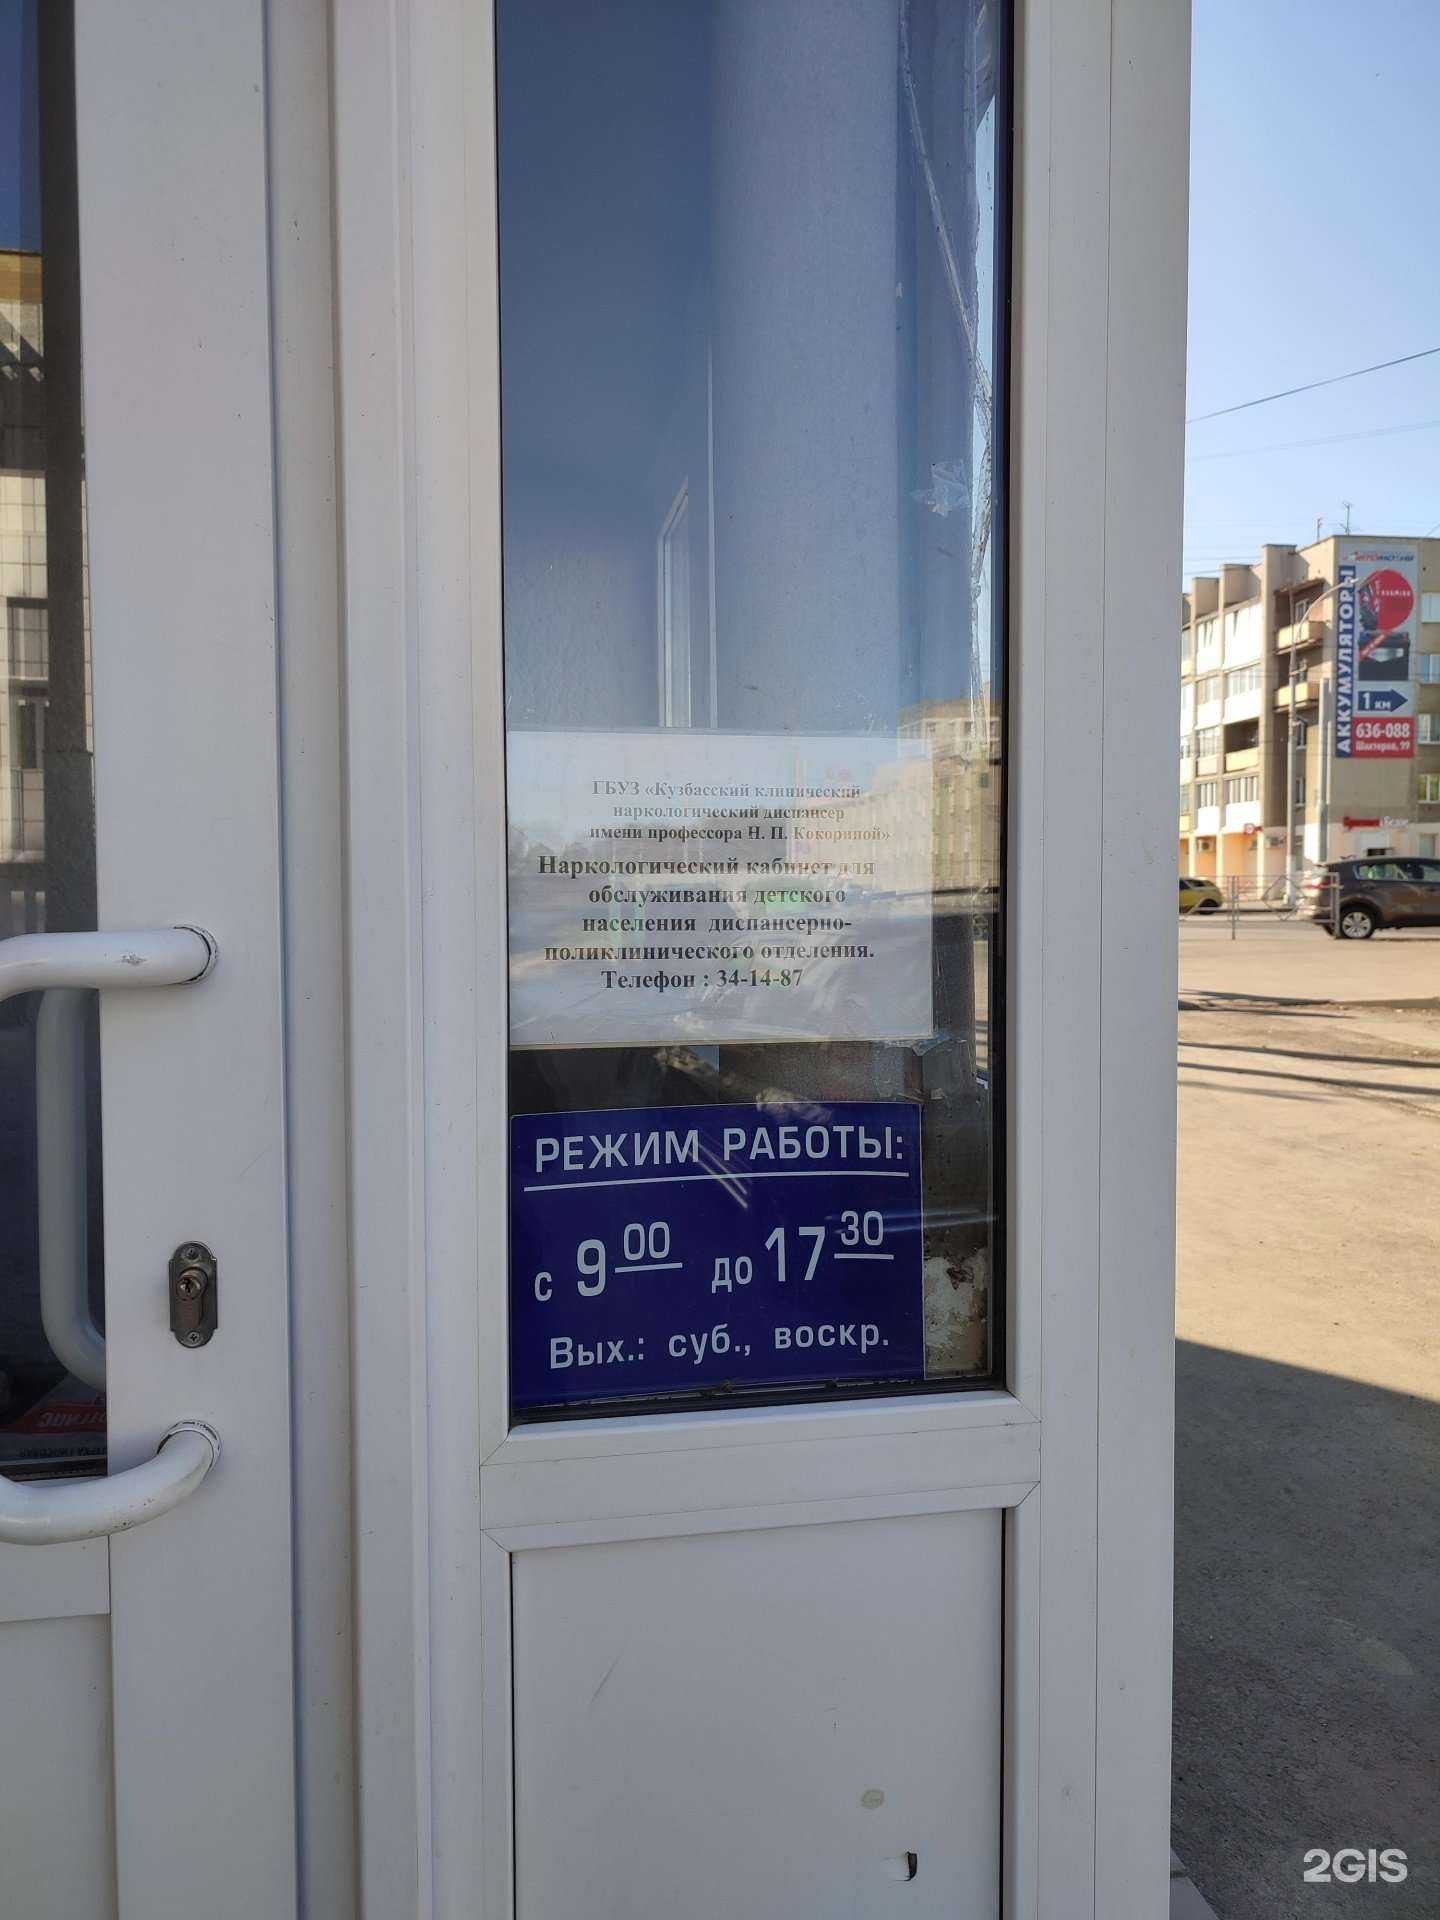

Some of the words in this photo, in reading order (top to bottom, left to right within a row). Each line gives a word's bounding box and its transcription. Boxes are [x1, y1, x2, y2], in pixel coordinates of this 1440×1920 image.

[1337, 569, 1354, 753] АККУМУЛЯТОРЫ
[1363, 692, 1371, 710] 1
[1356, 721, 1410, 738] 636-088
[592, 780, 640, 795] ГБУЗ
[755, 785, 860, 798] клинический
[613, 805, 759, 820] наркологический
[763, 808, 844, 822] диспансер
[590, 827, 641, 839] имени
[648, 826, 742, 843] профессора
[747, 827, 765, 840] Н.
[770, 827, 787, 840] П.
[539, 855, 739, 879] Наркологический
[747, 858, 832, 875] кабинет
[838, 862, 875, 877] для
[589, 885, 746, 906] обслуживания
[753, 888, 846, 905] детского
[583, 917, 696, 932] населения
[708, 916, 851, 934] диспансерно-
[544, 945, 753, 961] поликлинического
[761, 945, 874, 960] отделения.
[602, 970, 695, 992] Телефон
[716, 969, 802, 987] 34-14-87
[535, 1129, 699, 1173] РЕЖИМ
[723, 1125, 904, 1161] РАБОТЫ:
[534, 1271, 553, 1302] с
[711, 1256, 753, 1294] до
[549, 1335, 645, 1369] Вых.:
[668, 1324, 751, 1365] суб.,
[774, 1322, 889, 1355] воскр.
